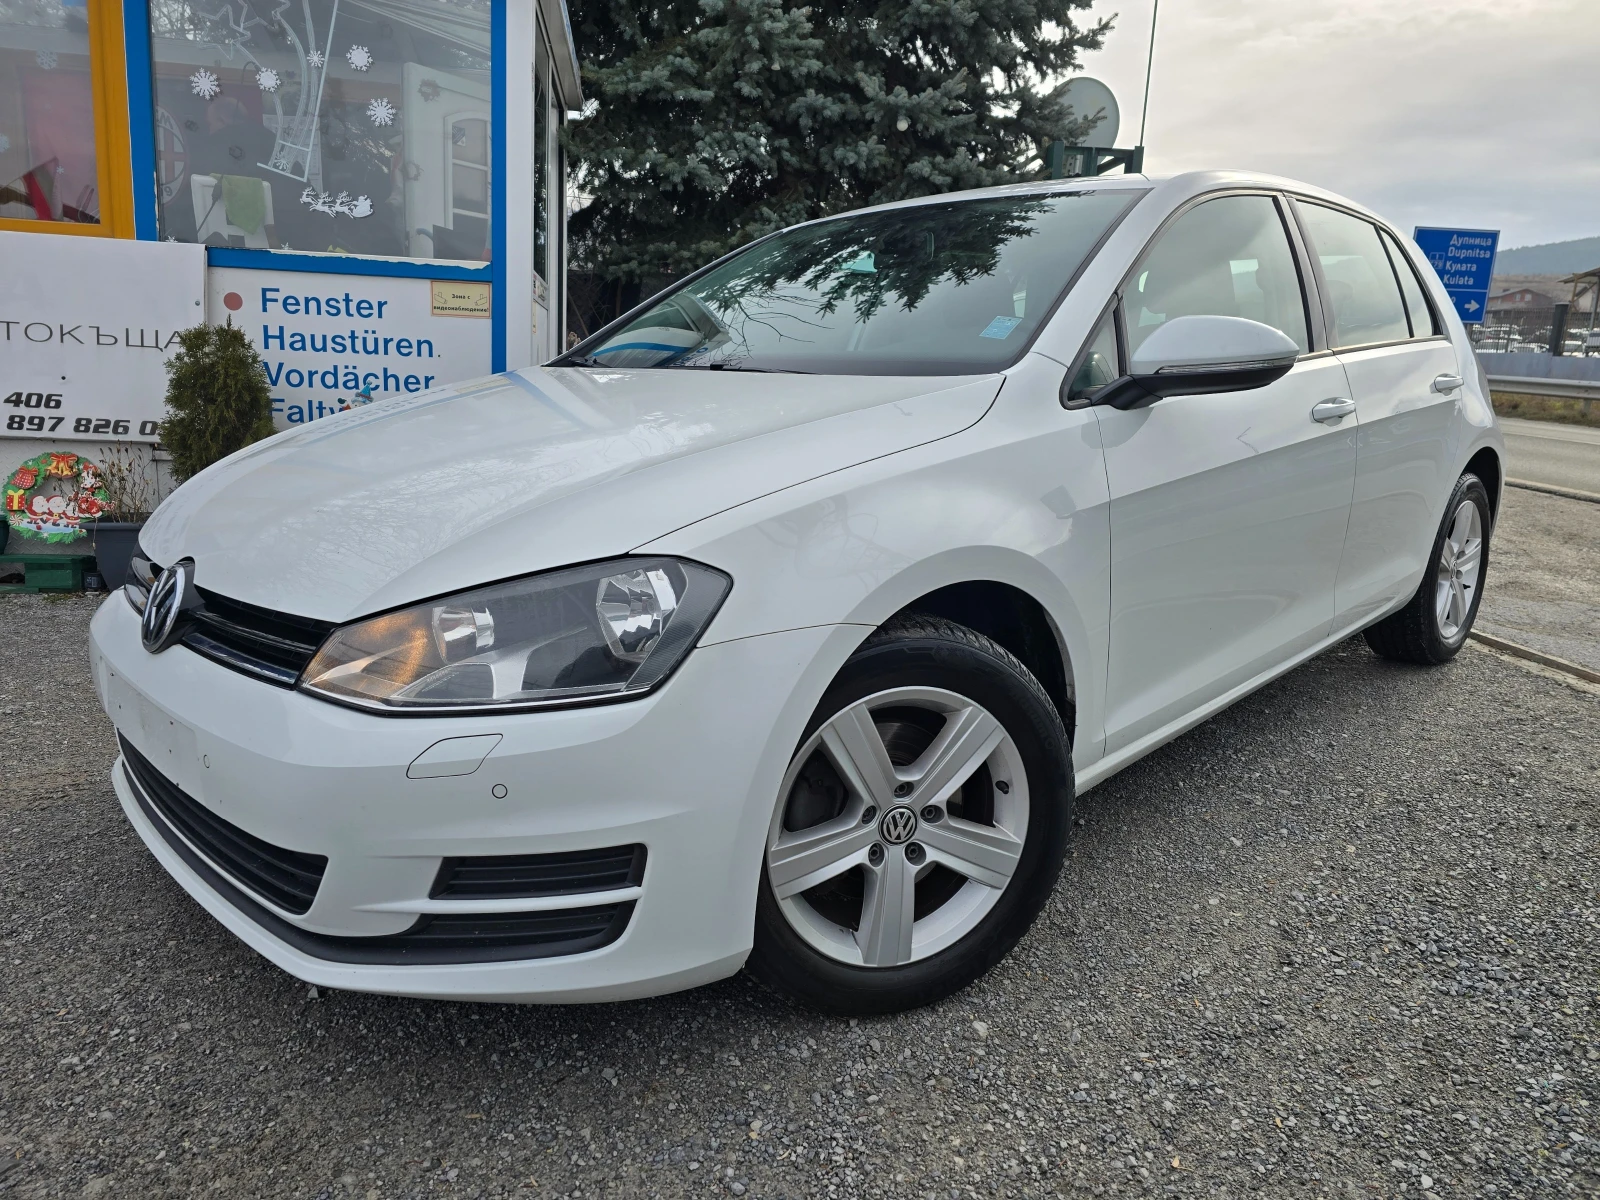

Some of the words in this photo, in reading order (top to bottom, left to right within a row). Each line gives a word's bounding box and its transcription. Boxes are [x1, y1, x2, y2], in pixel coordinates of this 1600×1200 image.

[1450, 233, 1492, 247] Дупница
[1448, 246, 1491, 259] Dupnitsa
[1445, 260, 1477, 273] Кулата
[1443, 274, 1474, 285] Kulata
[261, 287, 388, 319] Fenster
[263, 362, 435, 393] Vordächer
[3, 391, 63, 410] 406
[6, 414, 65, 432] 897
[73, 417, 131, 435] 826
